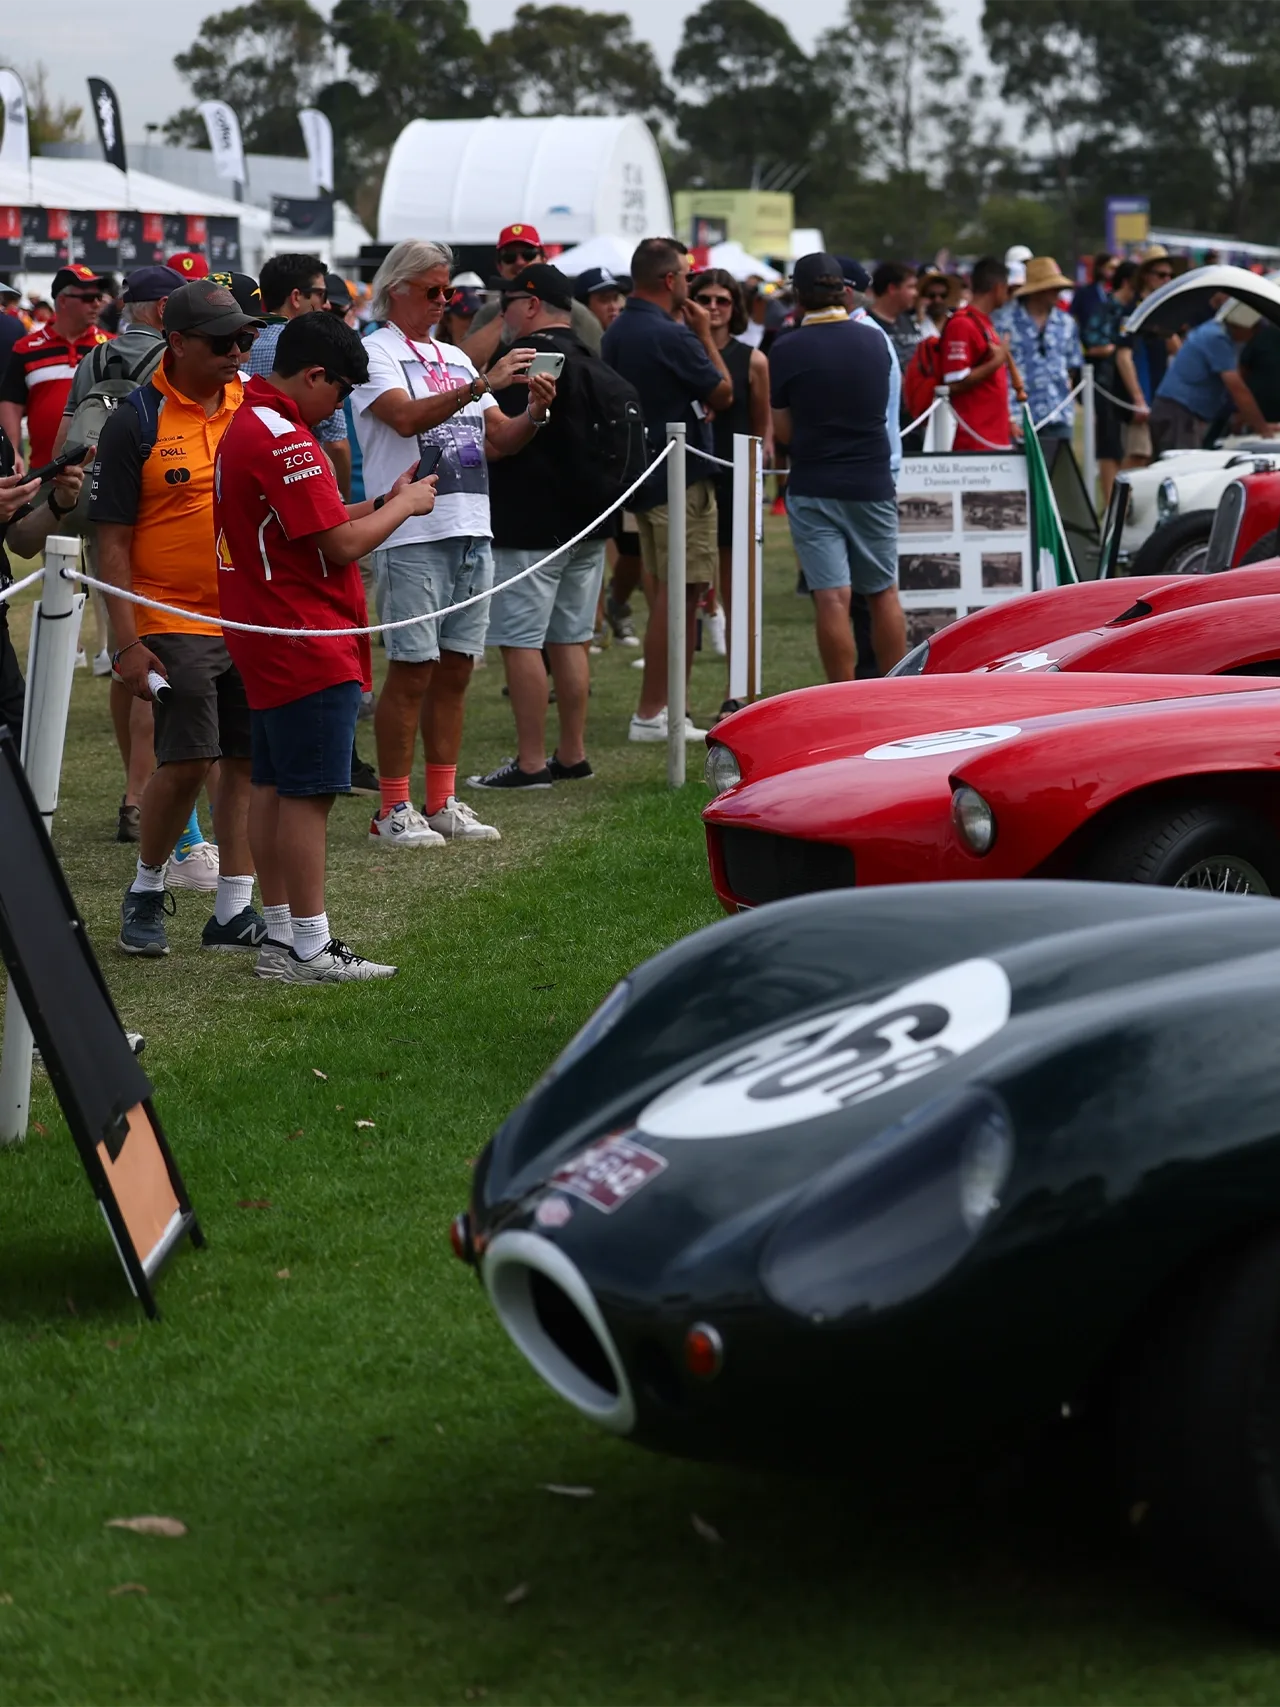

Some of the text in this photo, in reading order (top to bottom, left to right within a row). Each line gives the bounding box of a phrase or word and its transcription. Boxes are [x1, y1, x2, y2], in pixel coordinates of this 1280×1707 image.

[160, 448, 187, 457] DELL
[272, 440, 313, 457] Bitdefender
[284, 451, 314, 469] ZCG
[932, 463, 950, 473] Alfa
[952, 463, 989, 473] Romeo
